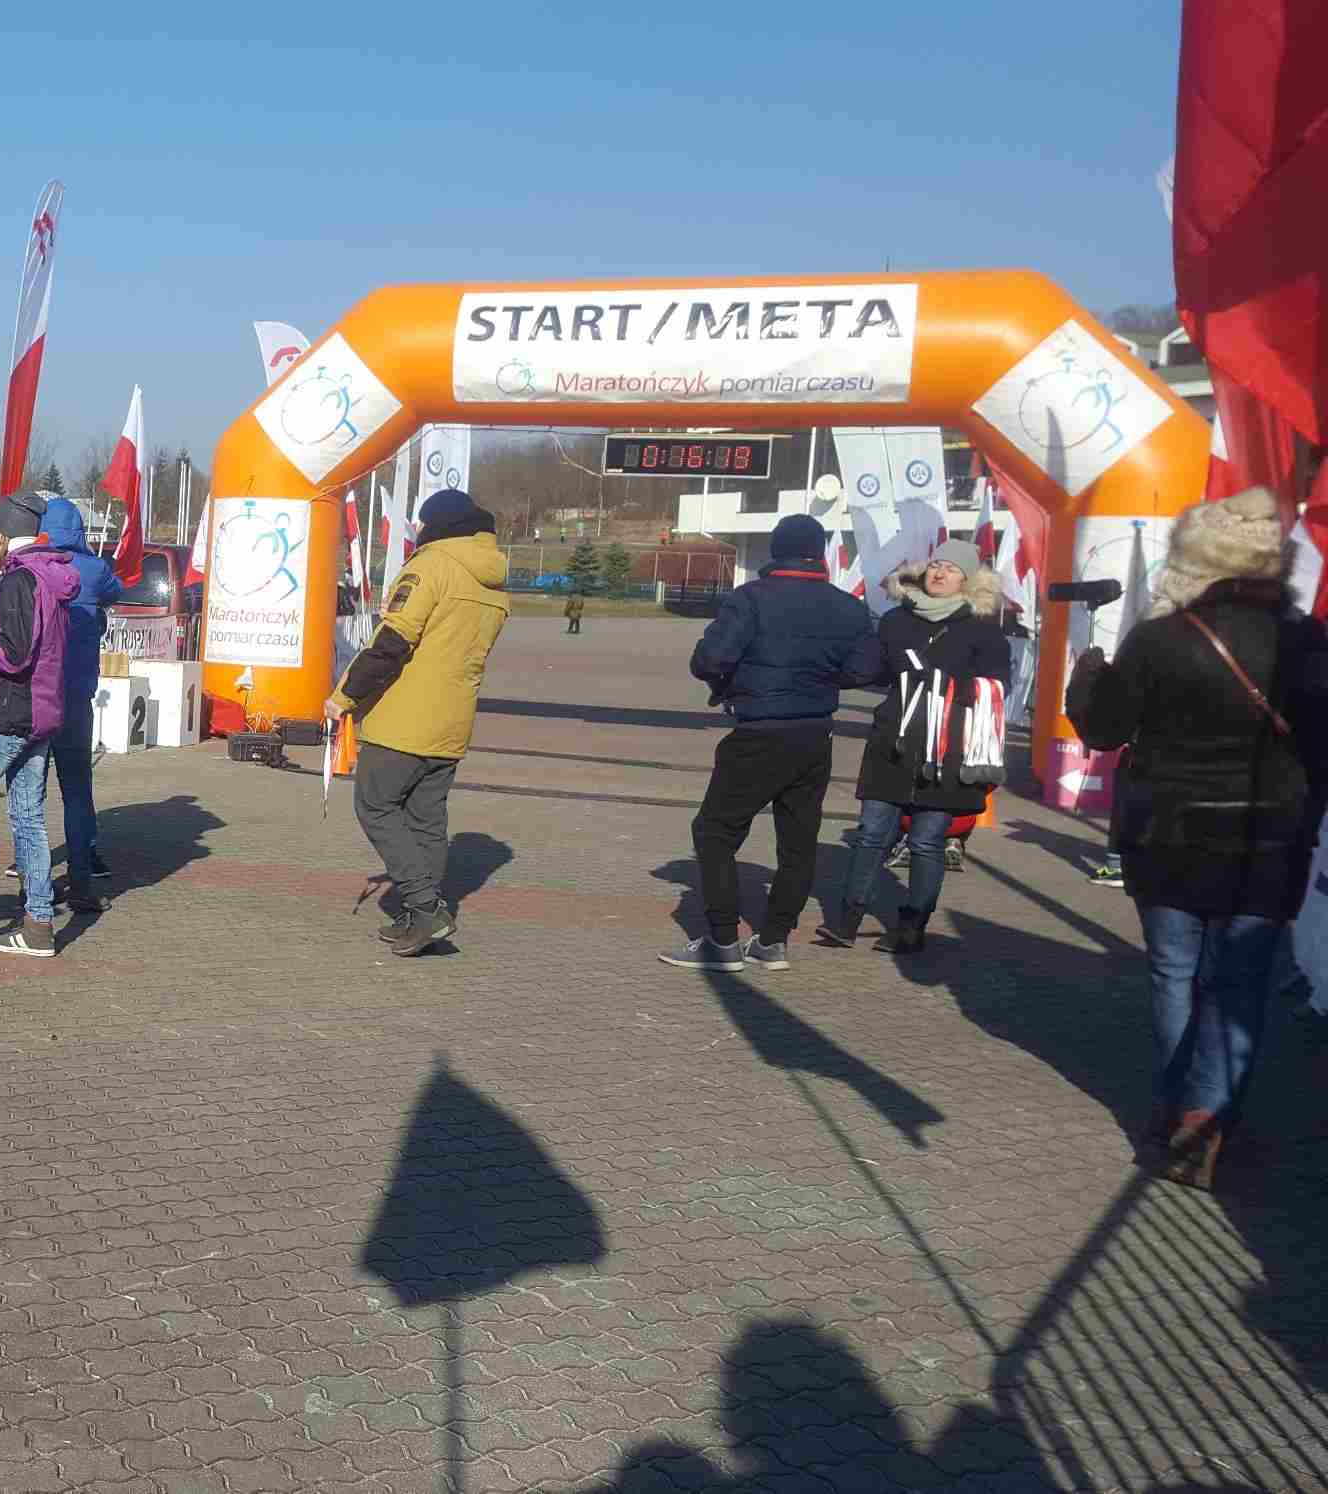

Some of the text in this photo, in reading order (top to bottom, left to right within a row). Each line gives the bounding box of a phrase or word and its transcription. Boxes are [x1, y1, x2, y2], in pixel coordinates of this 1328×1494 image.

[554, 370, 710, 397] Maratończyk
[208, 606, 301, 628] Maratończyk
[130, 695, 146, 745] 2
[187, 683, 195, 732] 1
